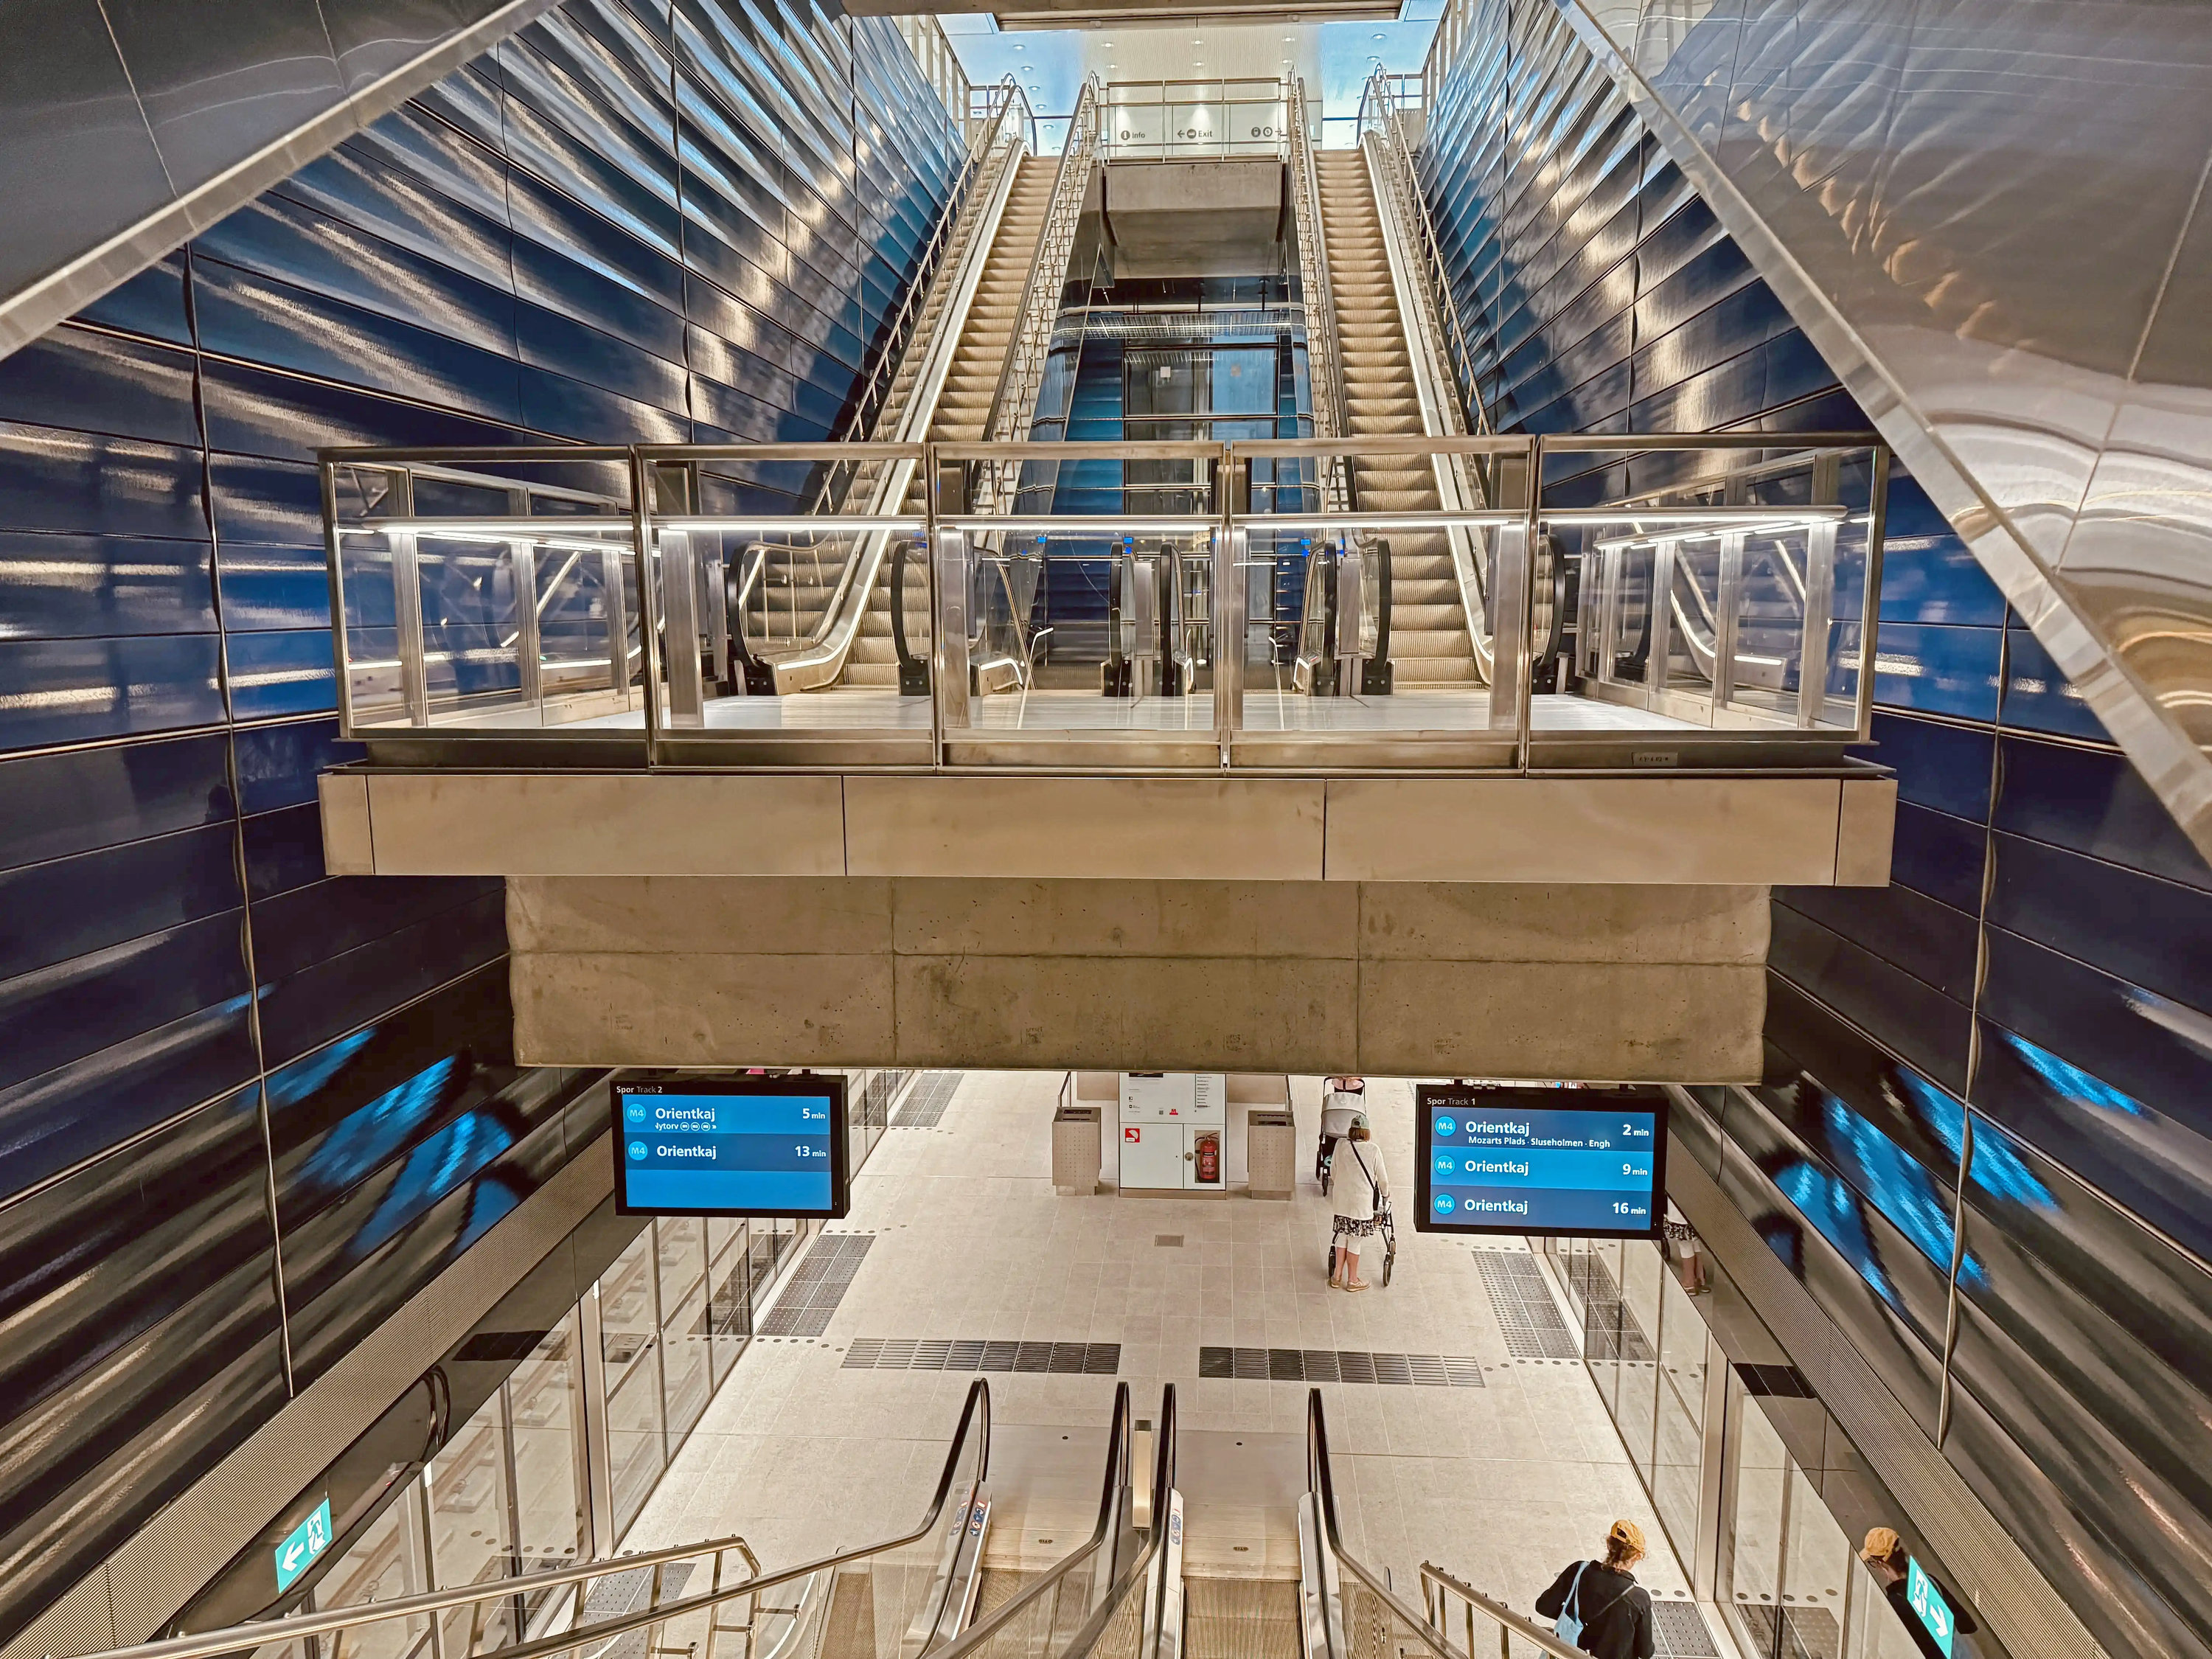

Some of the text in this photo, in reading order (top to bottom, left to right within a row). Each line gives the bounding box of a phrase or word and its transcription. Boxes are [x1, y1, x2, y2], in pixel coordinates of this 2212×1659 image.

[1198, 130, 1213, 138] Exit
[616, 1085, 635, 1095] Spor
[636, 1085, 656, 1093] Track
[1427, 1097, 1447, 1107] Spor
[1447, 1097, 1469, 1105] Track
[630, 1109, 644, 1117] M4
[655, 1107, 715, 1122] Orientkaj
[802, 1107, 810, 1119] 5
[1438, 1121, 1649, 1137] M4 Orientkaj 2 min
[1468, 1135, 1610, 1150] Mozarts Plads Sluseholmen Engh
[631, 1147, 646, 1155] M4
[656, 1145, 717, 1160] Orientkaj
[795, 1145, 810, 1157] 13
[1438, 1160, 1648, 1176] M4 Orientkaj 9 min
[1437, 1198, 1646, 1215] M4 Orientkaj 16 min
